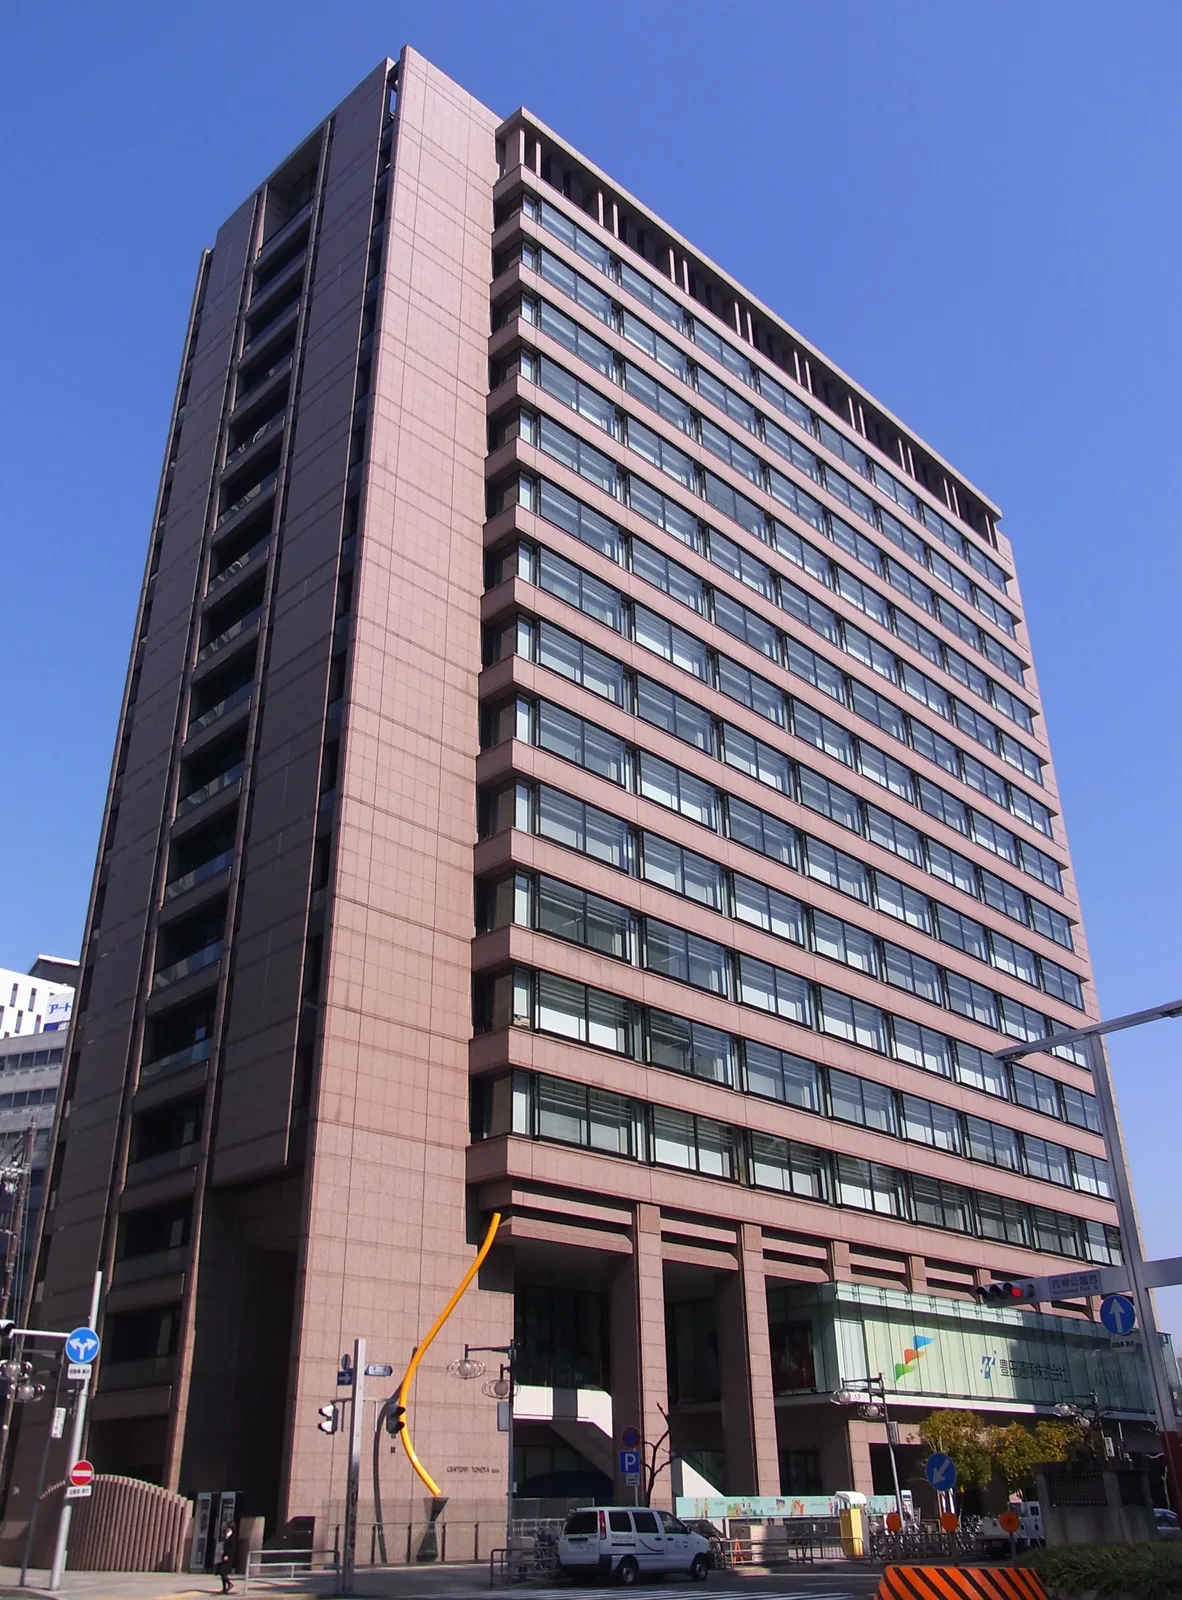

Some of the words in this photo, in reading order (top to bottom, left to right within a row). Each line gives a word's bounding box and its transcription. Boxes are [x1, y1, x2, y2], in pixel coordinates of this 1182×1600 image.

[49, 1002, 71, 1014] アート
[624, 1453, 636, 1472] P
[471, 1466, 490, 1474] TOYOTA
